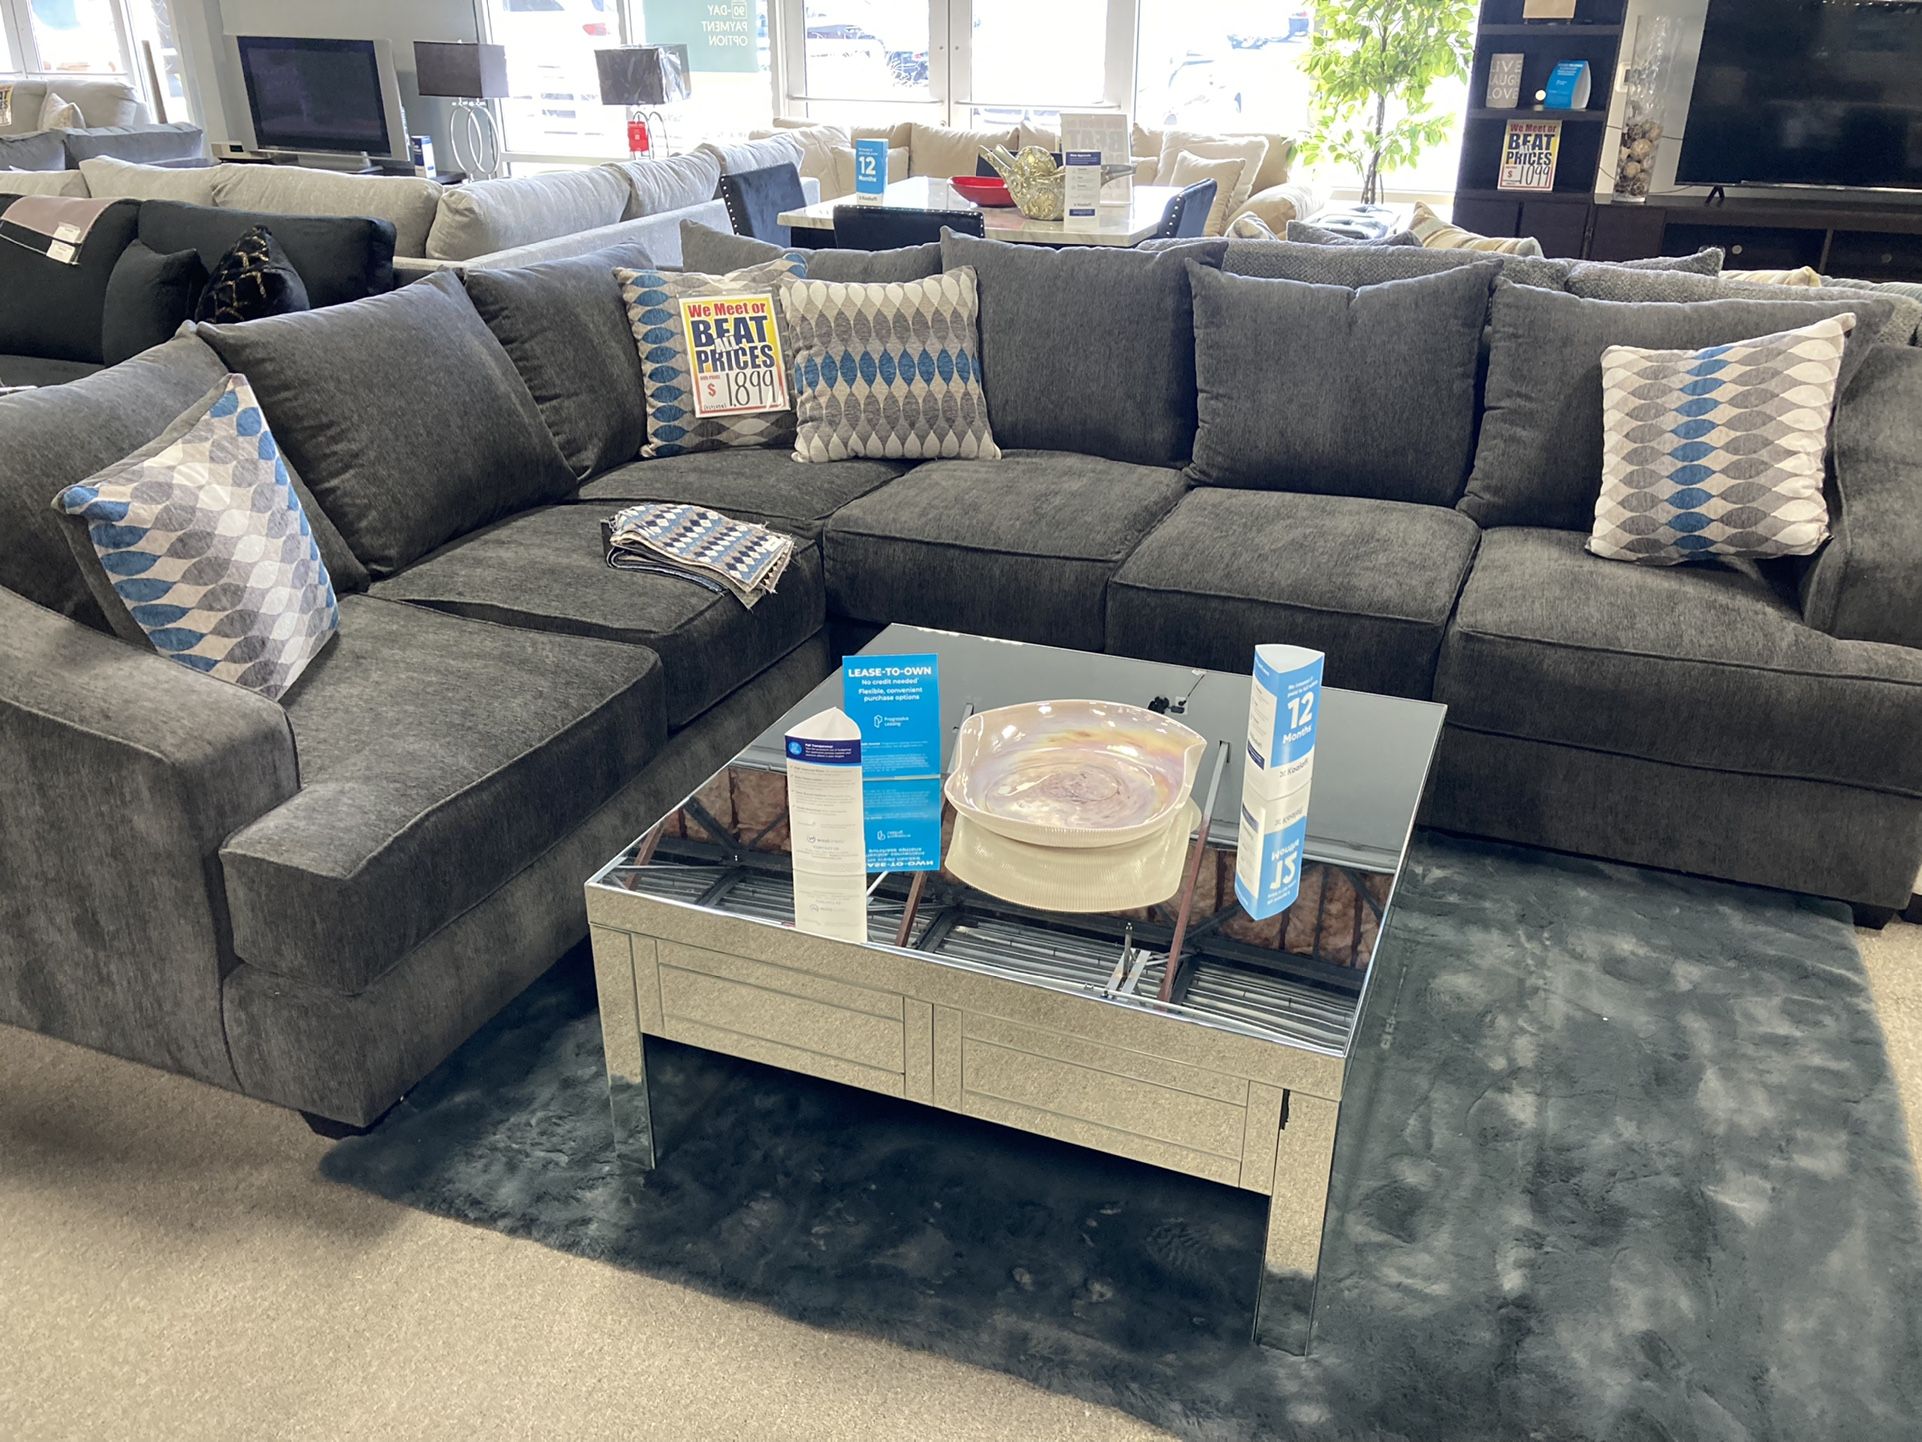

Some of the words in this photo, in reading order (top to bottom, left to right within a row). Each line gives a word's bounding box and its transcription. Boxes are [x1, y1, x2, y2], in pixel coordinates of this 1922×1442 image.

[1510, 124, 1523, 132] We
[1525, 124, 1546, 133] Meet
[1508, 133, 1555, 151] BEAT
[858, 156, 876, 175] 12
[1505, 151, 1552, 165] PRICES
[1520, 165, 1551, 186] 1099
[688, 304, 712, 318] We
[714, 303, 749, 316] Meet
[752, 302, 766, 313] or
[690, 315, 768, 348] BEAT
[714, 335, 740, 353] ALL
[695, 344, 775, 373] PRICES
[707, 382, 716, 397] $
[848, 666, 932, 677] LEASE-TO-OWN
[864, 694, 894, 702] purchase
[1287, 691, 1314, 730] 12
[1282, 725, 1312, 745] Months
